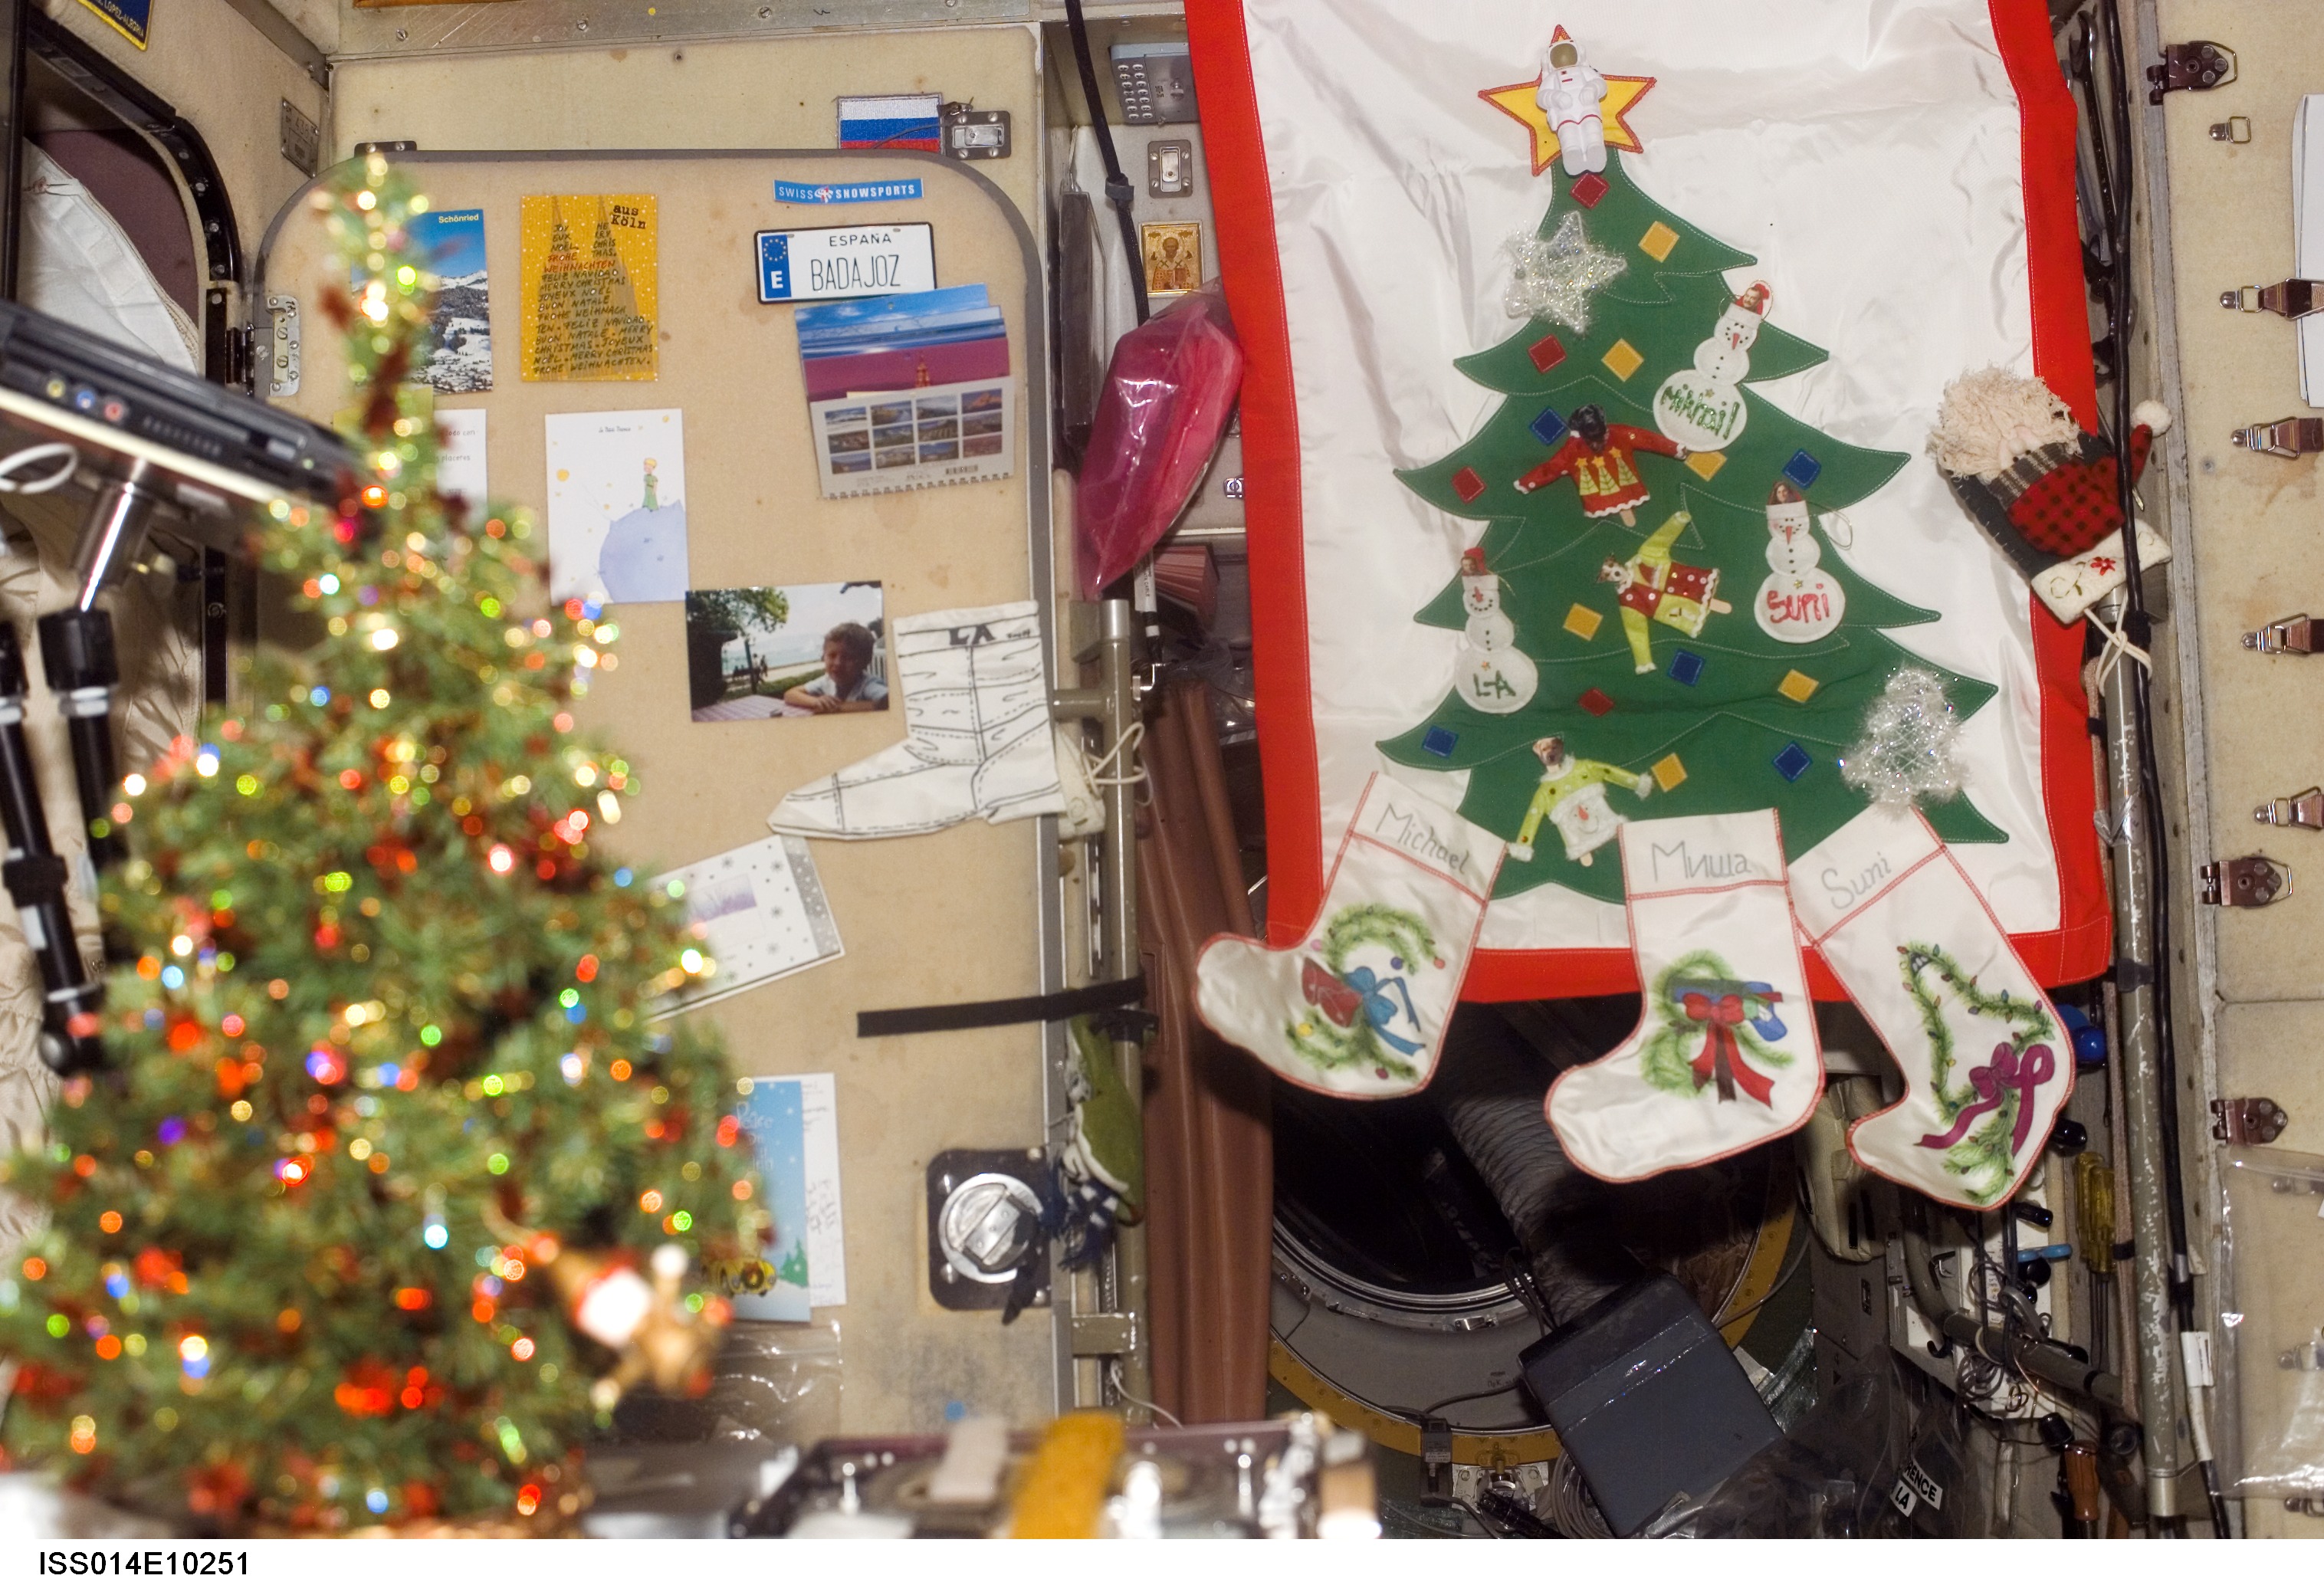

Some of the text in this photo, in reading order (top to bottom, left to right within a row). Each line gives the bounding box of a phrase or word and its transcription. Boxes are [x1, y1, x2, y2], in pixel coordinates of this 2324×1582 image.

[779, 184, 914, 199] SWISS SNOWSPORTS
[438, 213, 479, 223] Schönried
[613, 205, 638, 216] aus
[611, 214, 647, 229] Köln
[553, 234, 572, 242] EUX
[592, 238, 616, 249] CHRIS
[829, 232, 891, 247] ESPAÑA
[547, 252, 577, 262] FROHE
[543, 260, 616, 273] WEIHNACHTEN
[811, 254, 901, 291] BADAJOZ
[541, 269, 619, 282] FELIZ NAVIDAD
[771, 271, 783, 289] E
[539, 277, 625, 291] MERRY CHRISTMAS
[538, 290, 576, 302] JOYEUX
[538, 295, 610, 312] BUON NATALE
[537, 305, 626, 321] FROHE WEIHNACH
[563, 318, 599, 330] FELIZ
[536, 334, 562, 345] BUON
[619, 324, 653, 335] MERRY
[602, 335, 643, 346] JOYEUX
[570, 350, 603, 361] MERRY
[606, 344, 653, 357] CHRISTMAS
[533, 363, 564, 374] FROHE
[1767, 583, 1830, 623] Suni
[1375, 802, 1470, 875] Michael
[1651, 840, 1752, 883] Миша
[1820, 851, 1891, 910] Suni
[1895, 1486, 1910, 1510] LA
